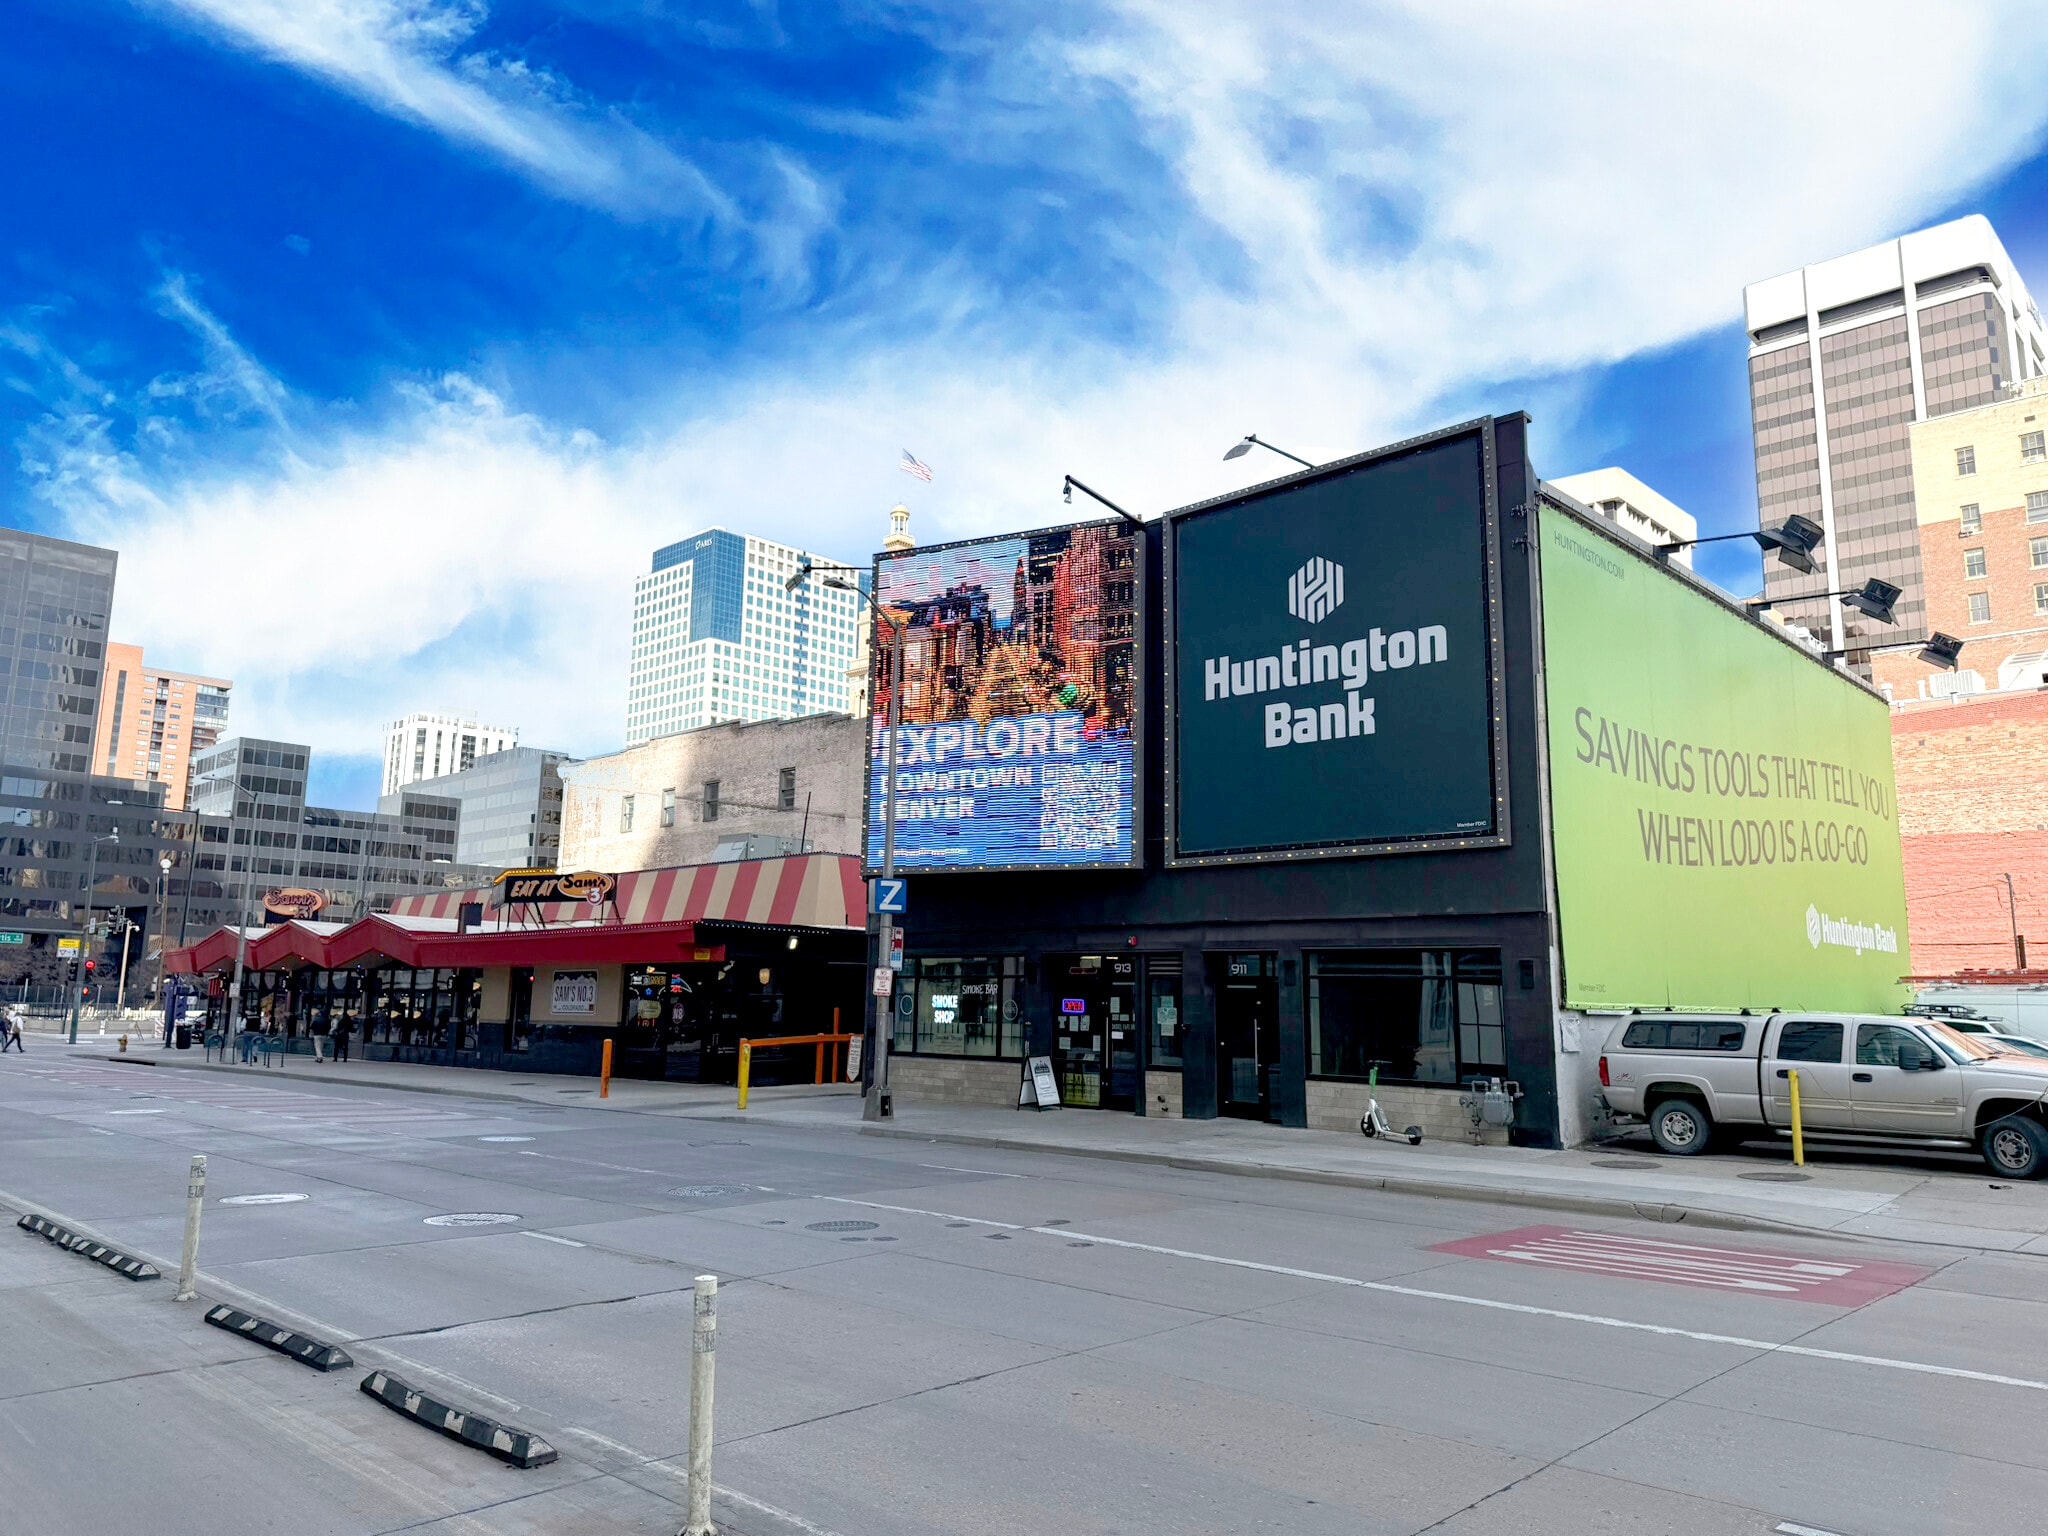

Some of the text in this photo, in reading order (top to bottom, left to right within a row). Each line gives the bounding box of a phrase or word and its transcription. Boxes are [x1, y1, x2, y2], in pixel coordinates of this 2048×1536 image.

[1554, 530, 1625, 581] HUNTINGTON.COM
[1204, 624, 1448, 701] Huntington
[1264, 690, 1376, 748] Bank
[881, 715, 1080, 765] EXPLORE
[1574, 706, 1890, 821] SAVINGS TOOLS THAT TELL YOU
[1637, 808, 1868, 867] WHEN LODO IS A GO-GO
[510, 879, 559, 897] EAT AT
[563, 874, 607, 888] Sam's
[267, 887, 317, 905] Sam's
[590, 887, 600, 902] 3
[879, 881, 902, 911] Z
[1821, 912, 1898, 956] Huntington Bank
[1114, 963, 1132, 973] 913
[1231, 963, 1248, 975] 911
[554, 985, 594, 1002] SAM'S NO.3
[962, 983, 998, 995] SMOKE BAR
[932, 994, 958, 1009] SMOKE
[1064, 1001, 1083, 1011] OPEN
[934, 1010, 955, 1024] SHOP
